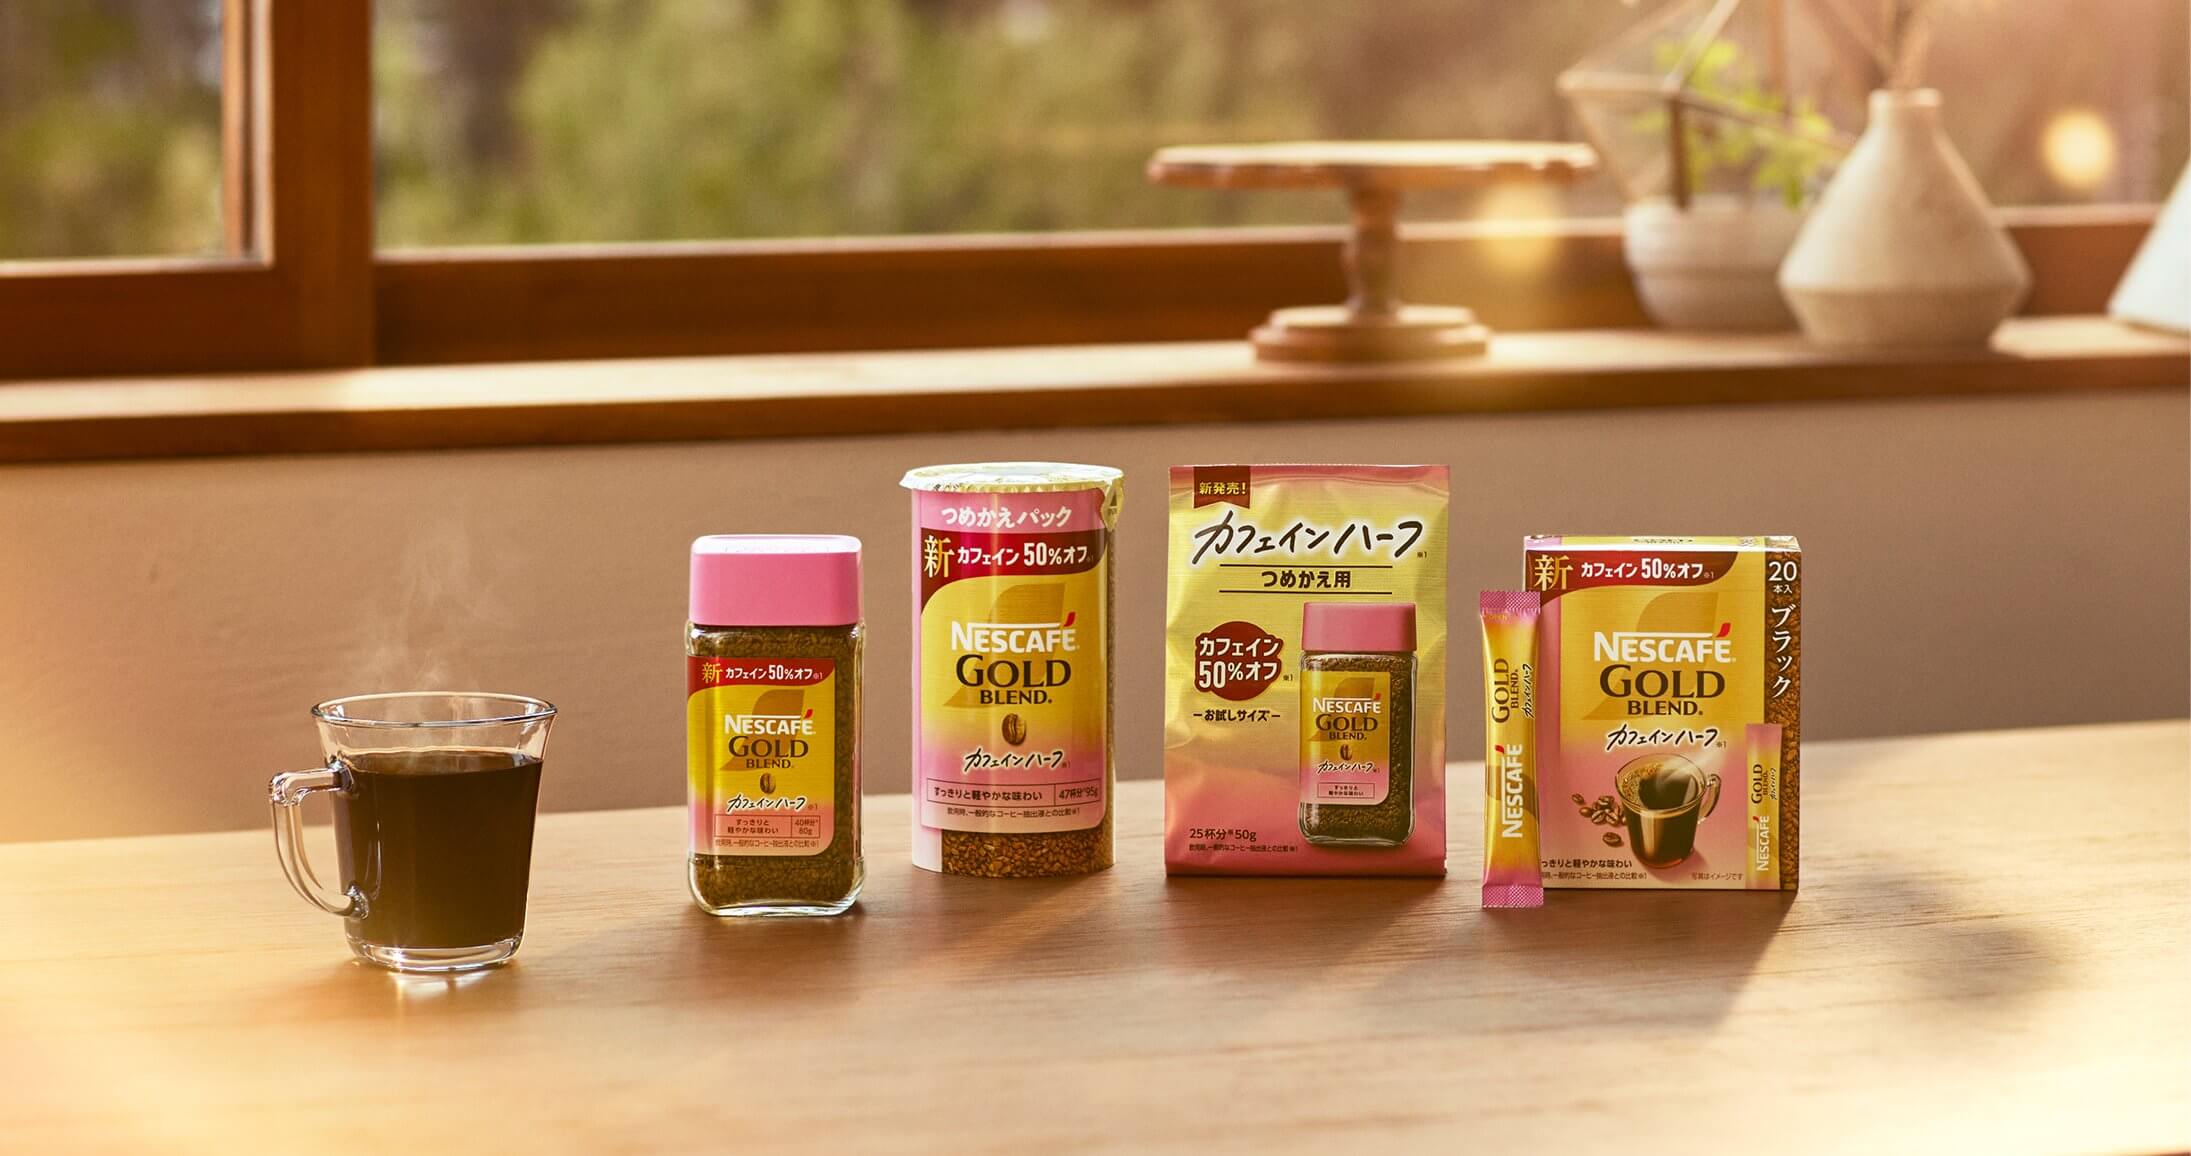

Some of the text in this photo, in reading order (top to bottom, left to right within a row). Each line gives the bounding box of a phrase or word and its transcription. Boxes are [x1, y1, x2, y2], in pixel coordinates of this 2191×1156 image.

[1199, 481, 1247, 495] 新発売!
[941, 507, 1073, 529] つめかえパック
[1191, 509, 1424, 565] カフェインハーフ
[924, 535, 955, 579] 新
[1261, 570, 1351, 588] つめかえ用
[1533, 554, 1574, 592] 新
[1768, 561, 1798, 581] 20
[1772, 584, 1793, 594] 本入
[951, 611, 1077, 654] NESCAFÉ
[1594, 623, 1732, 663] NESCAFÉ
[1199, 637, 1279, 657] カフェイン
[1771, 603, 1797, 699] ブラック
[702, 661, 723, 683] 新
[956, 654, 1072, 688] GOLD
[1199, 661, 1278, 689] 50%オフ
[1600, 664, 1726, 698] GOLD
[1313, 692, 1382, 714] NESCAFÉ
[1491, 658, 1510, 723] GOLD
[724, 708, 815, 736] NESCAFÉ
[1316, 714, 1378, 732] GOLD
[728, 735, 809, 758] GOLD
[1606, 724, 1718, 751] カフェインハーフ
[964, 748, 1064, 772] カフェインハーフ
[934, 786, 1043, 801] すっきりと軽やかな味わい
[1494, 744, 1524, 838] NESCAFÉ
[1751, 764, 1763, 804] GOLD
[727, 794, 806, 812] カフェインハーフ
[1541, 859, 1633, 868] っきりと軽やかな味わい
